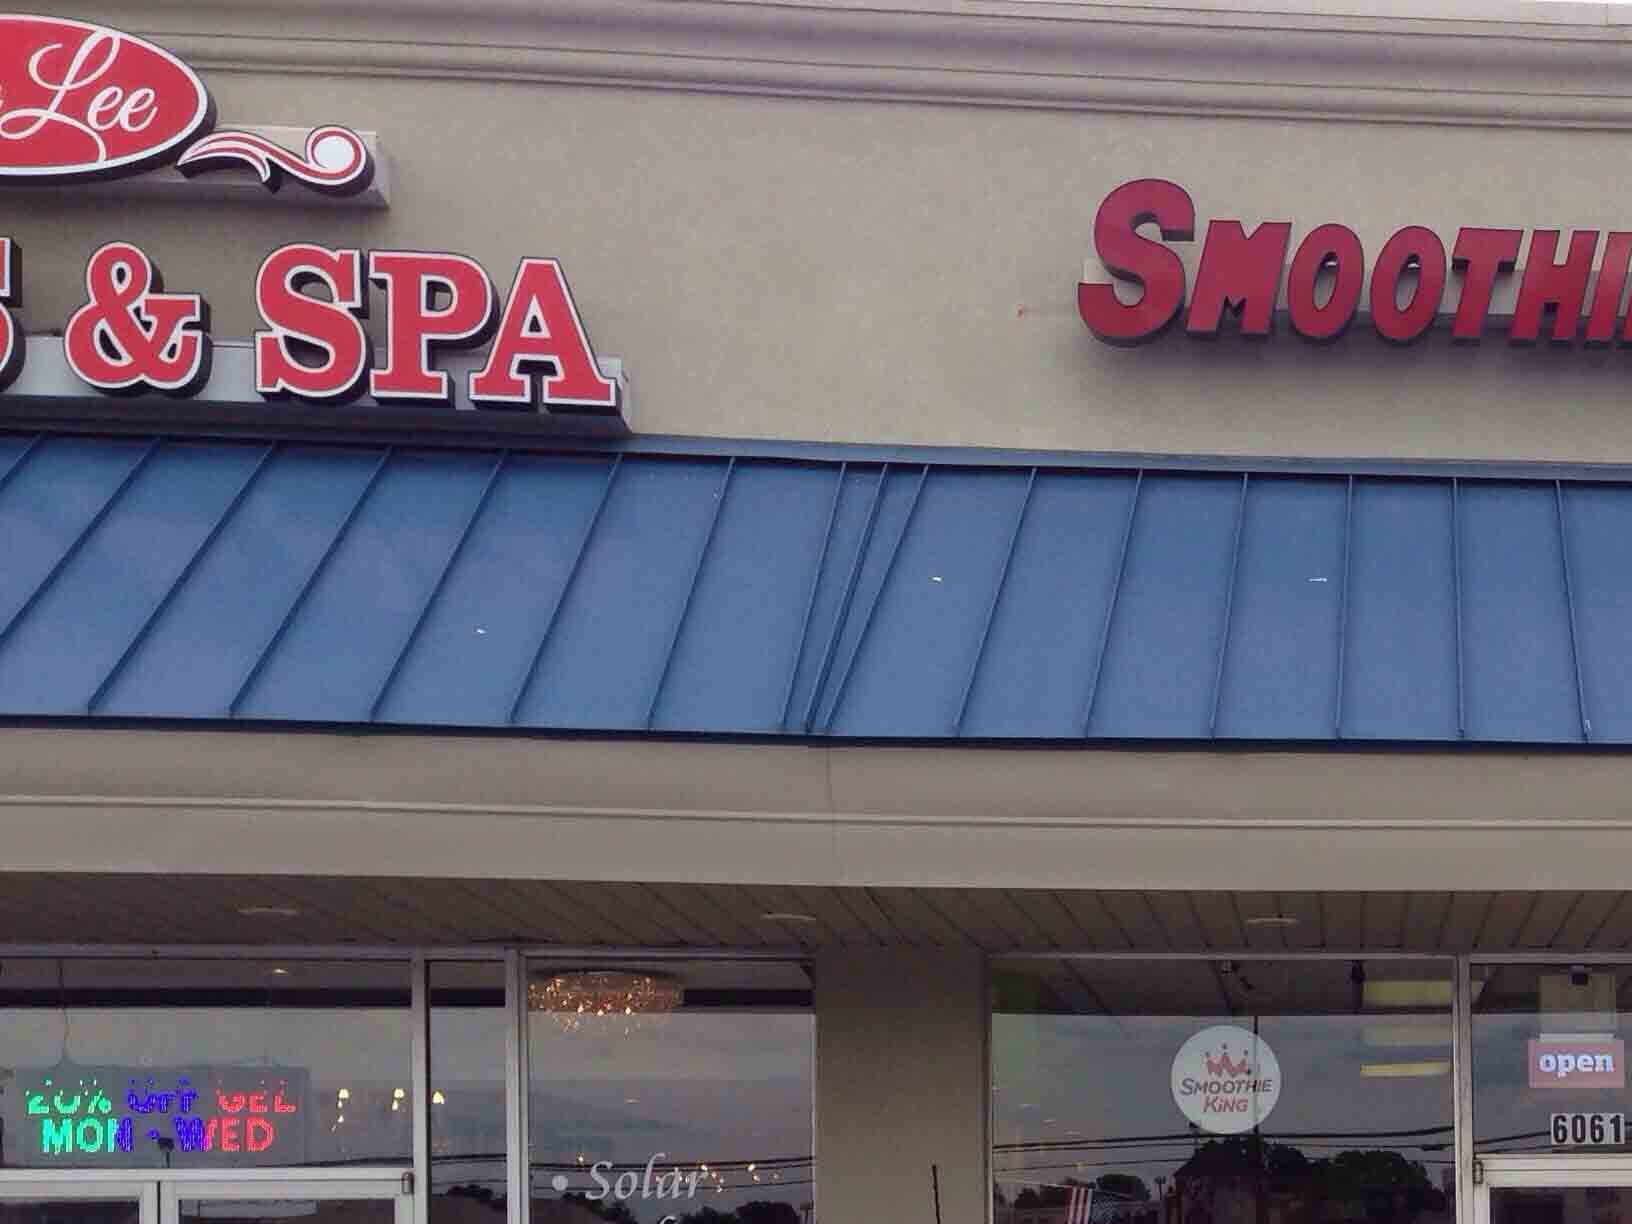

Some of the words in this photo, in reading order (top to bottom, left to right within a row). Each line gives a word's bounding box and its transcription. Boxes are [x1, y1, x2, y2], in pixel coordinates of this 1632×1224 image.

[0, 31, 158, 163] Lee
[256, 243, 616, 407] SPA
[1539, 1053, 1615, 1078] open
[40, 1116, 133, 1153] MON
[174, 1116, 274, 1152] WED
[1552, 1113, 1622, 1144] 6061
[585, 1153, 708, 1200] Solar
